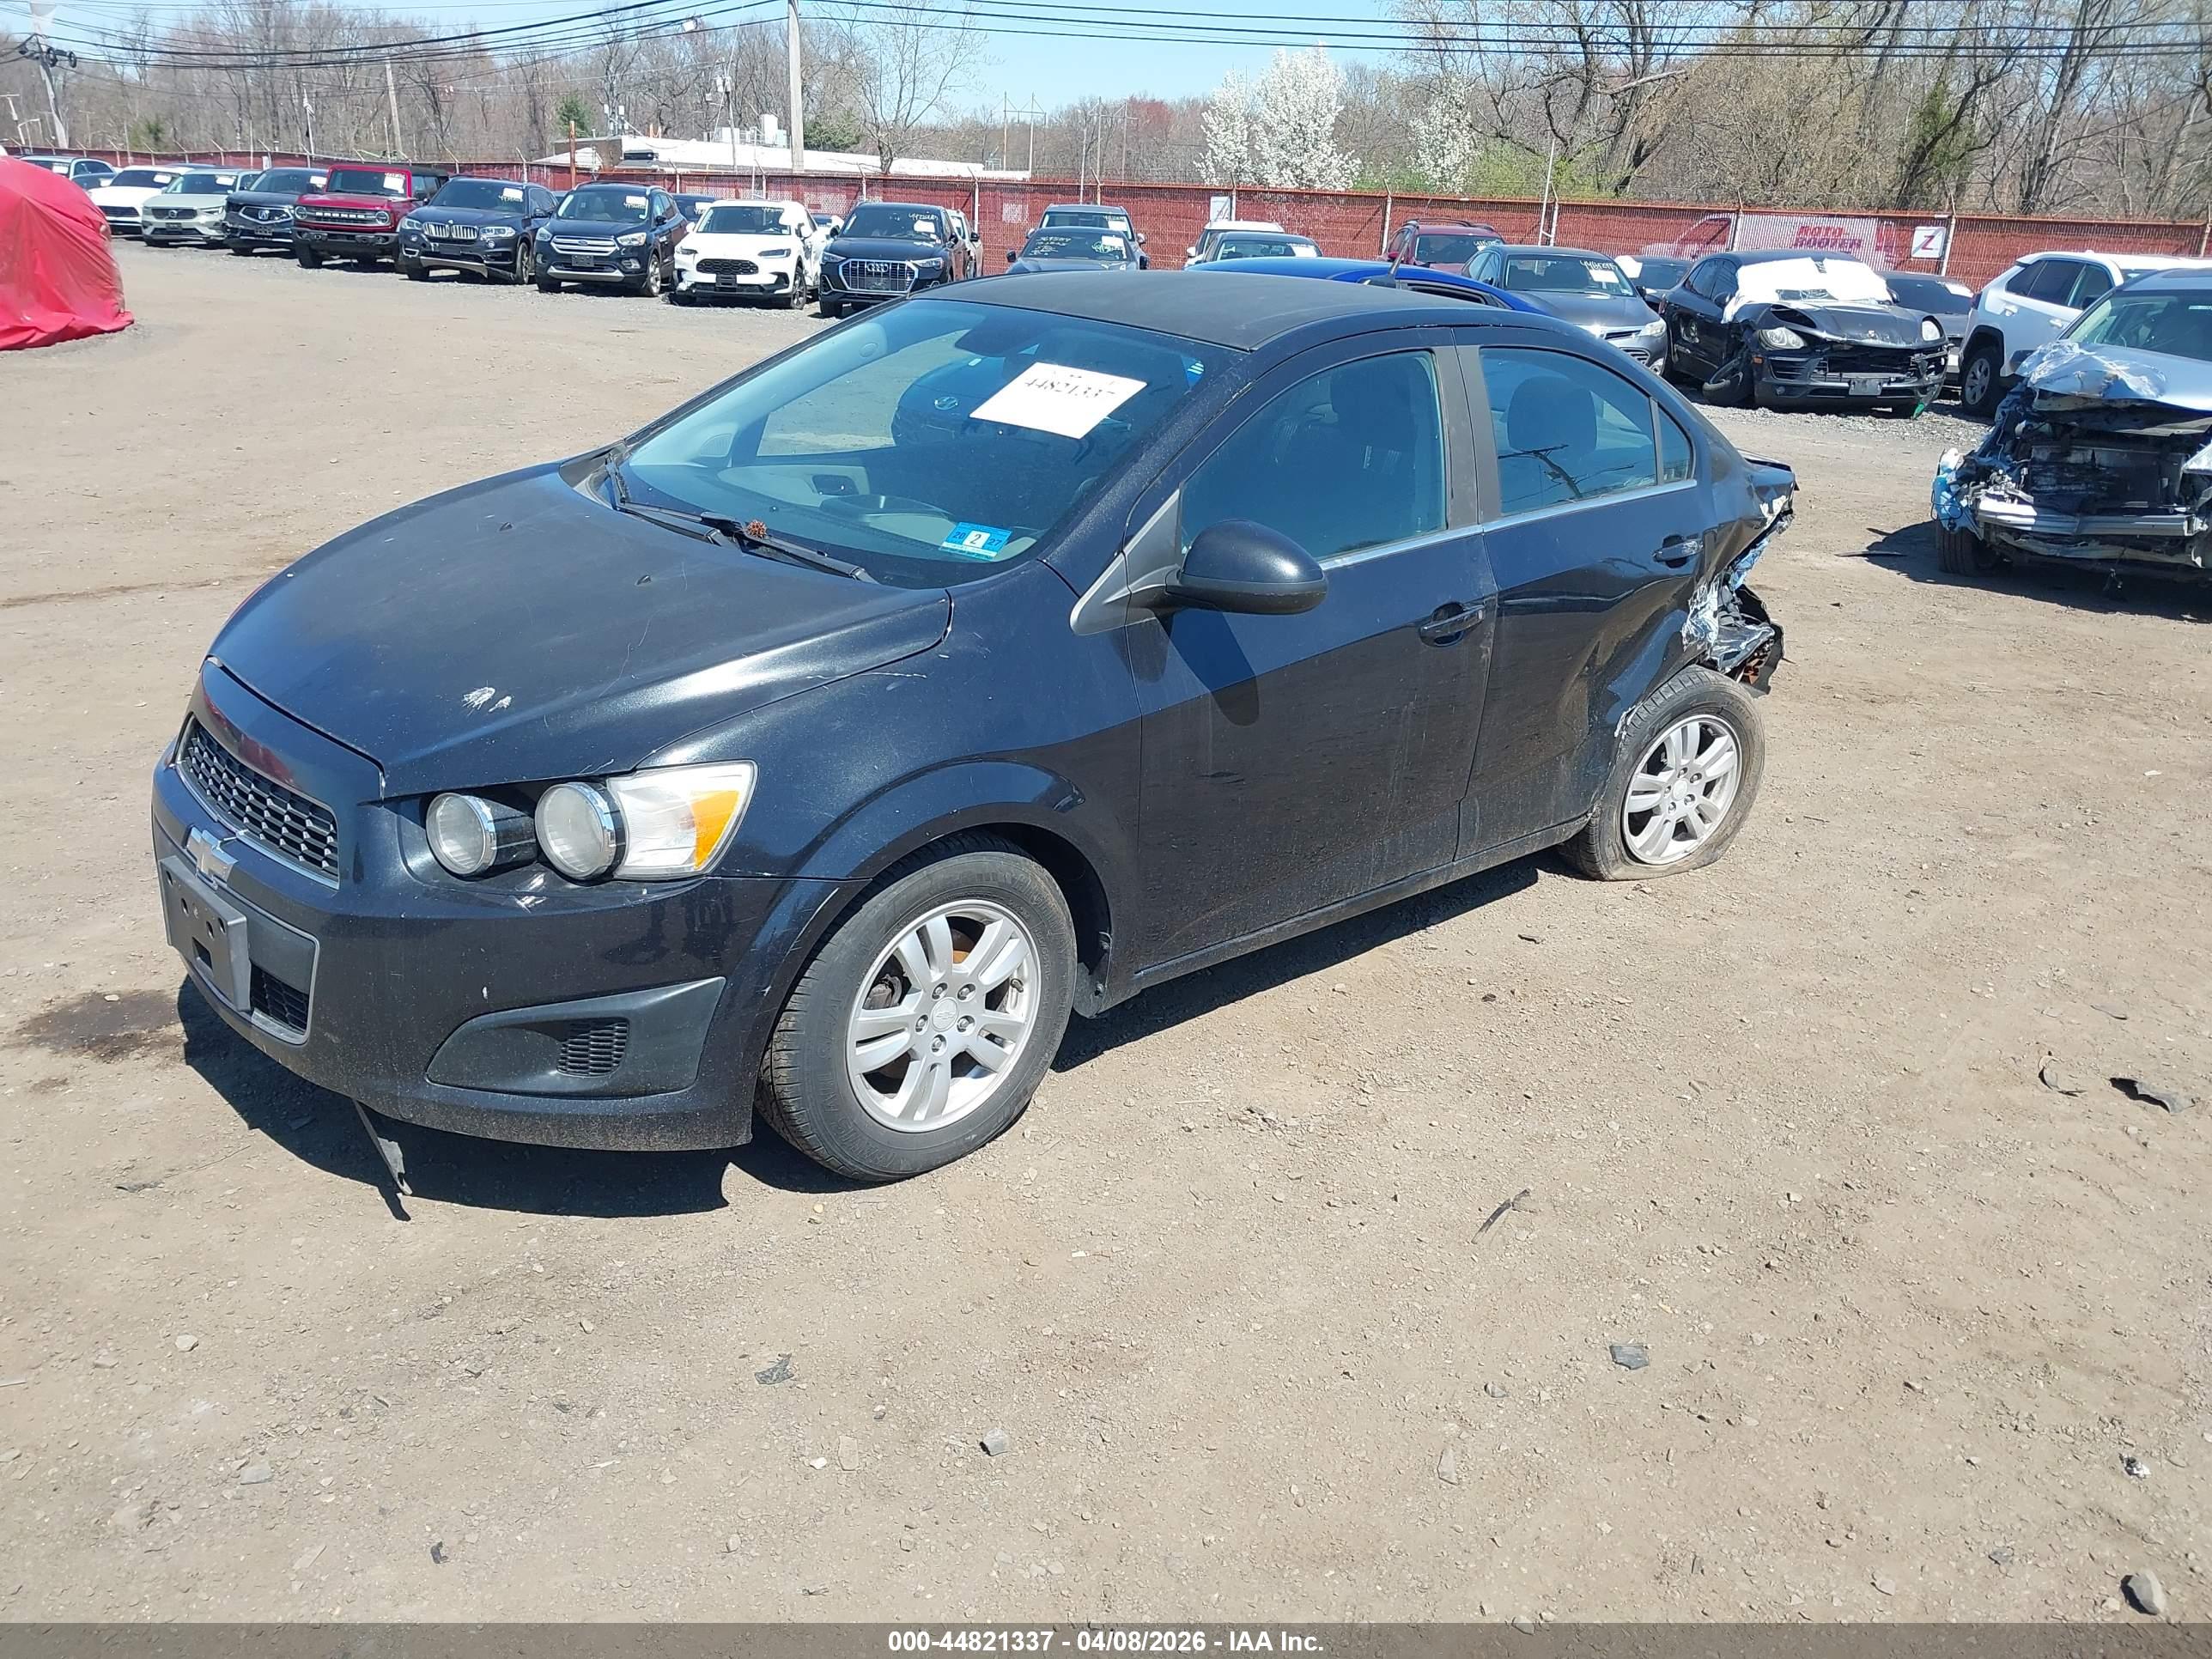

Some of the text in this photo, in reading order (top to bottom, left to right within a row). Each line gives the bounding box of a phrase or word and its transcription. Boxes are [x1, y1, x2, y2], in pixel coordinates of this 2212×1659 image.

[1921, 234, 1936, 250] Z
[952, 531, 1003, 546] 20 2 27
